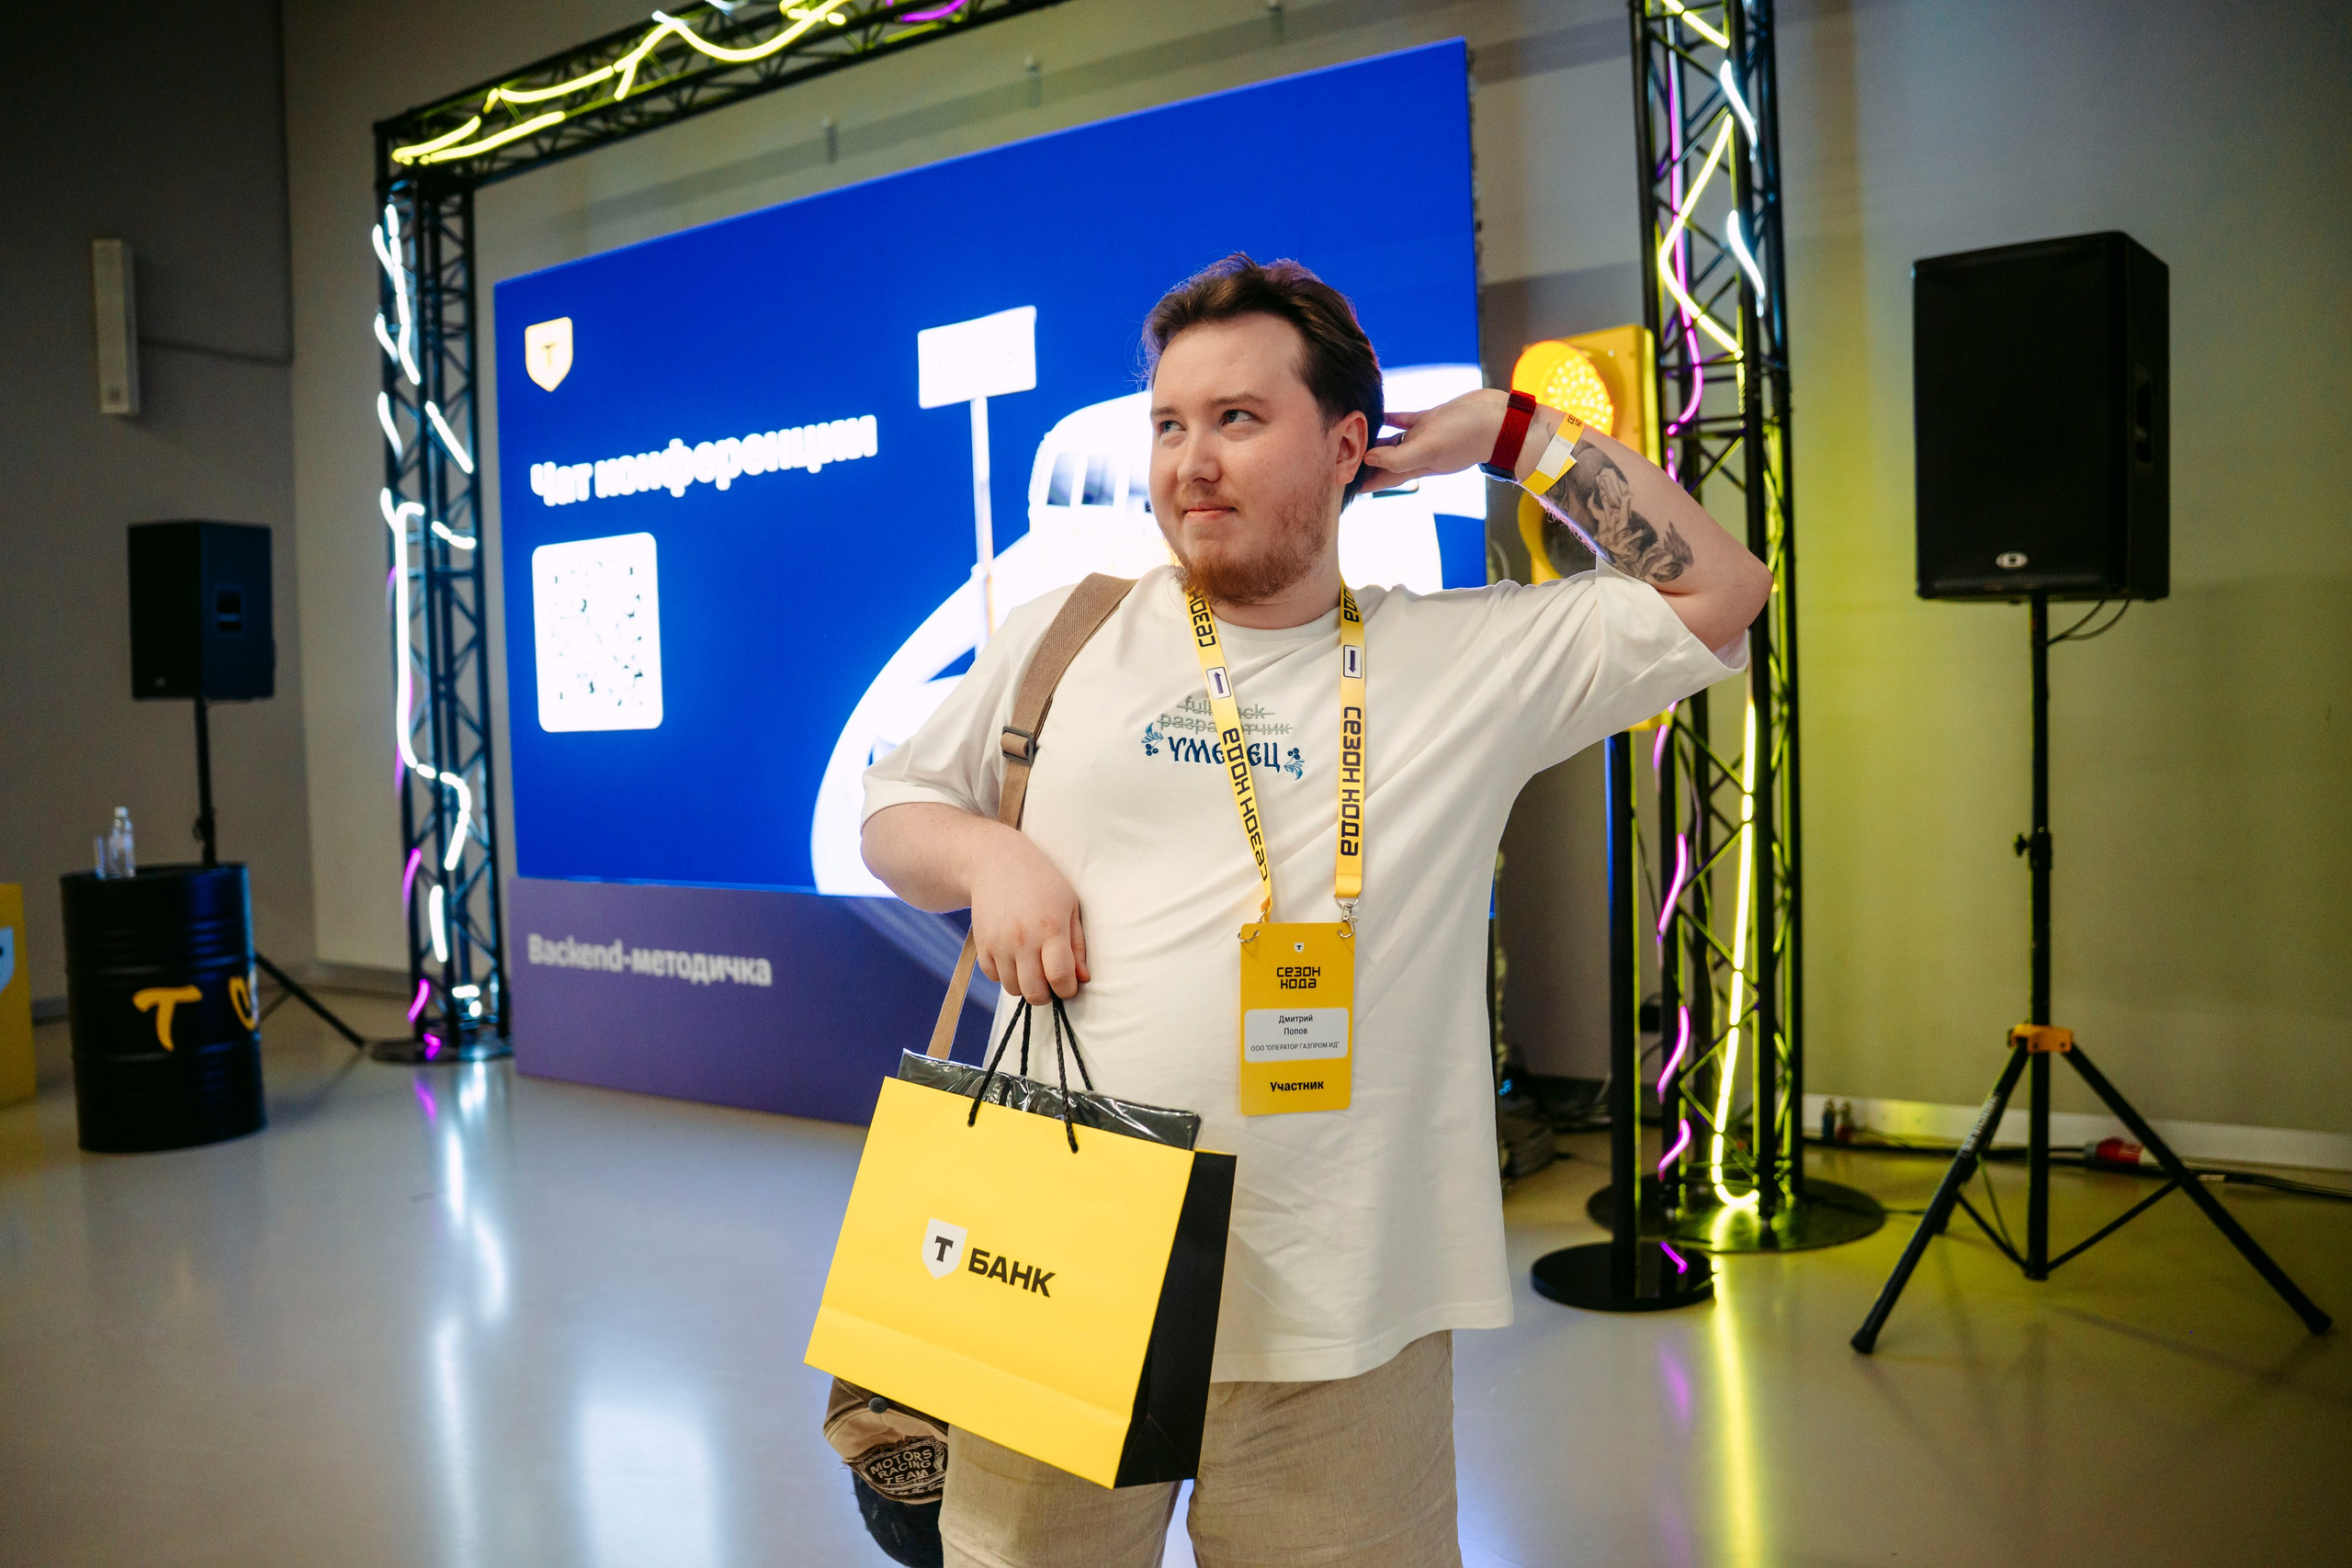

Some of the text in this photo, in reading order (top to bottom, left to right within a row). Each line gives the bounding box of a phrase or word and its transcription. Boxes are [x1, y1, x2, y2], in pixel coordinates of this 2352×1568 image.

[530, 414, 877, 507] Чат конференции
[1159, 713, 1290, 736] разратчик
[1168, 736, 1280, 773] УМЕЕЦ
[527, 933, 773, 987] Backend-методичка
[1278, 1014, 1313, 1024] Дмитрий
[1270, 1081, 1324, 1091] Участник
[934, 1235, 1057, 1298] Т БАНК
[869, 1449, 933, 1474] MOTORS
[877, 1459, 932, 1479] RACING
[884, 1469, 929, 1485] TEAM
